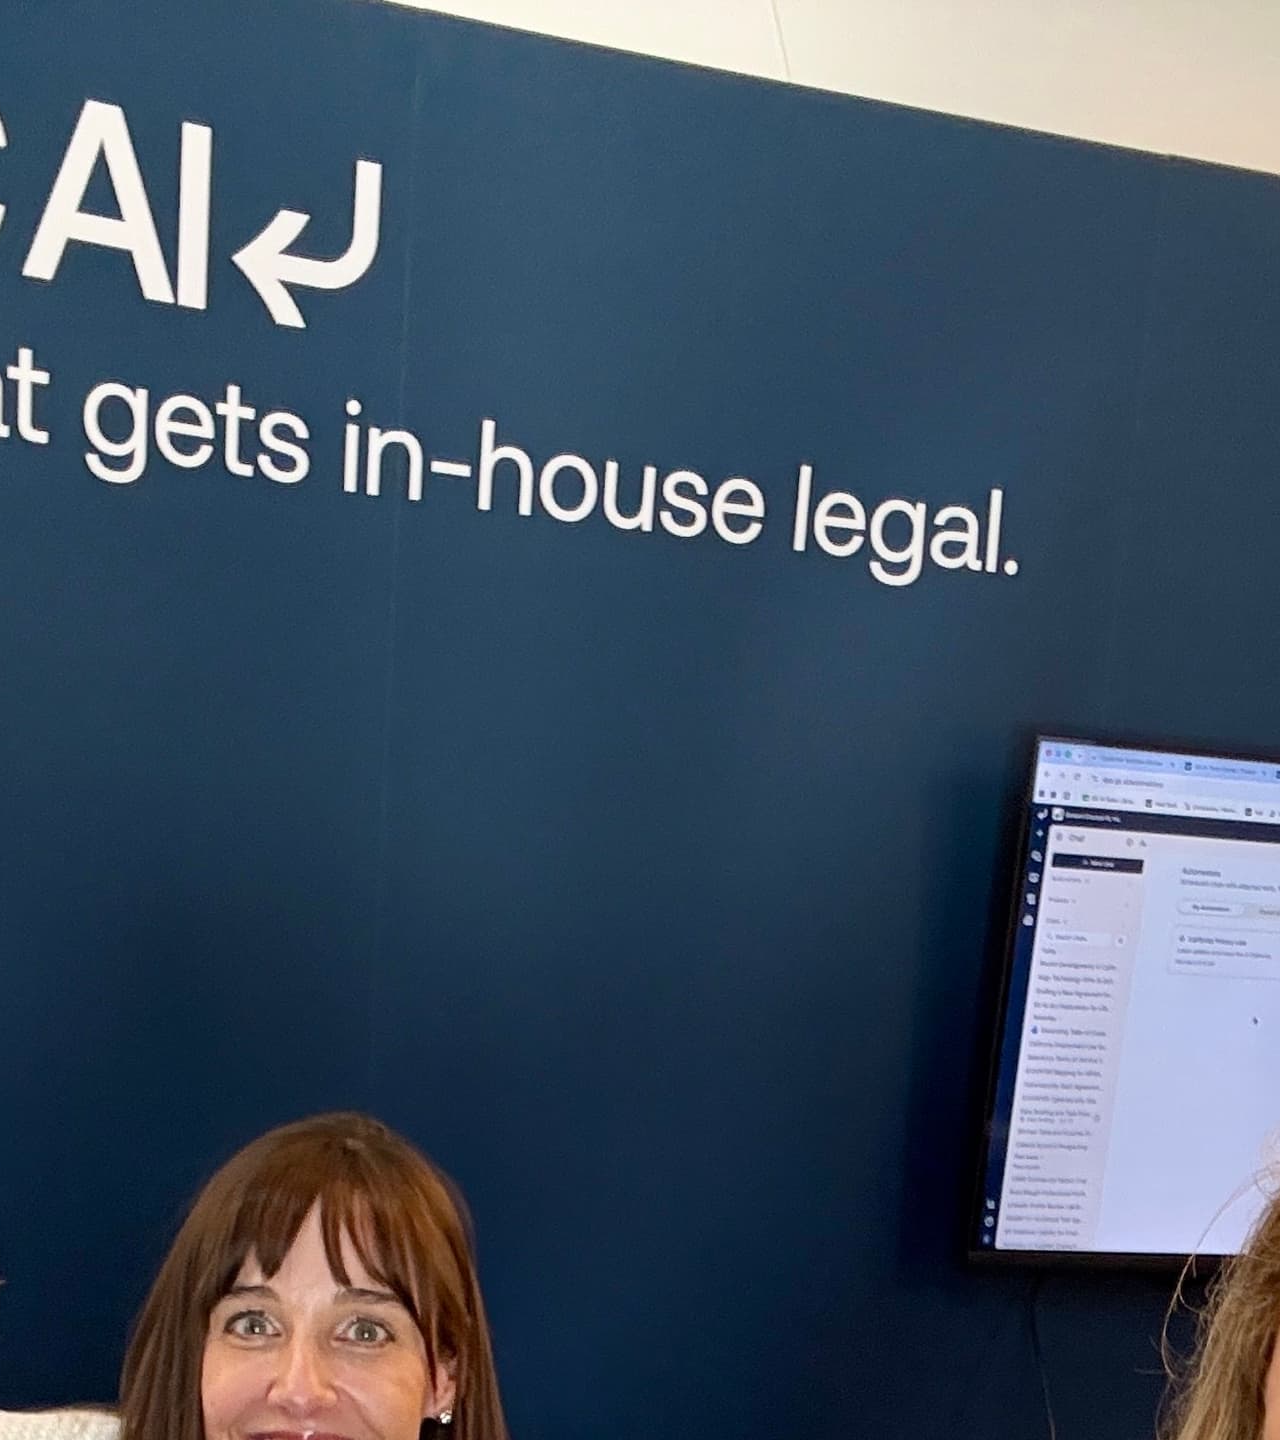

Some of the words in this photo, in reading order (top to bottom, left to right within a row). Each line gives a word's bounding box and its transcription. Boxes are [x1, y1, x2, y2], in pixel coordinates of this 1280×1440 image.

[83, 382, 310, 484] gets
[343, 399, 765, 545] in-house
[793, 464, 1018, 587] legal.
